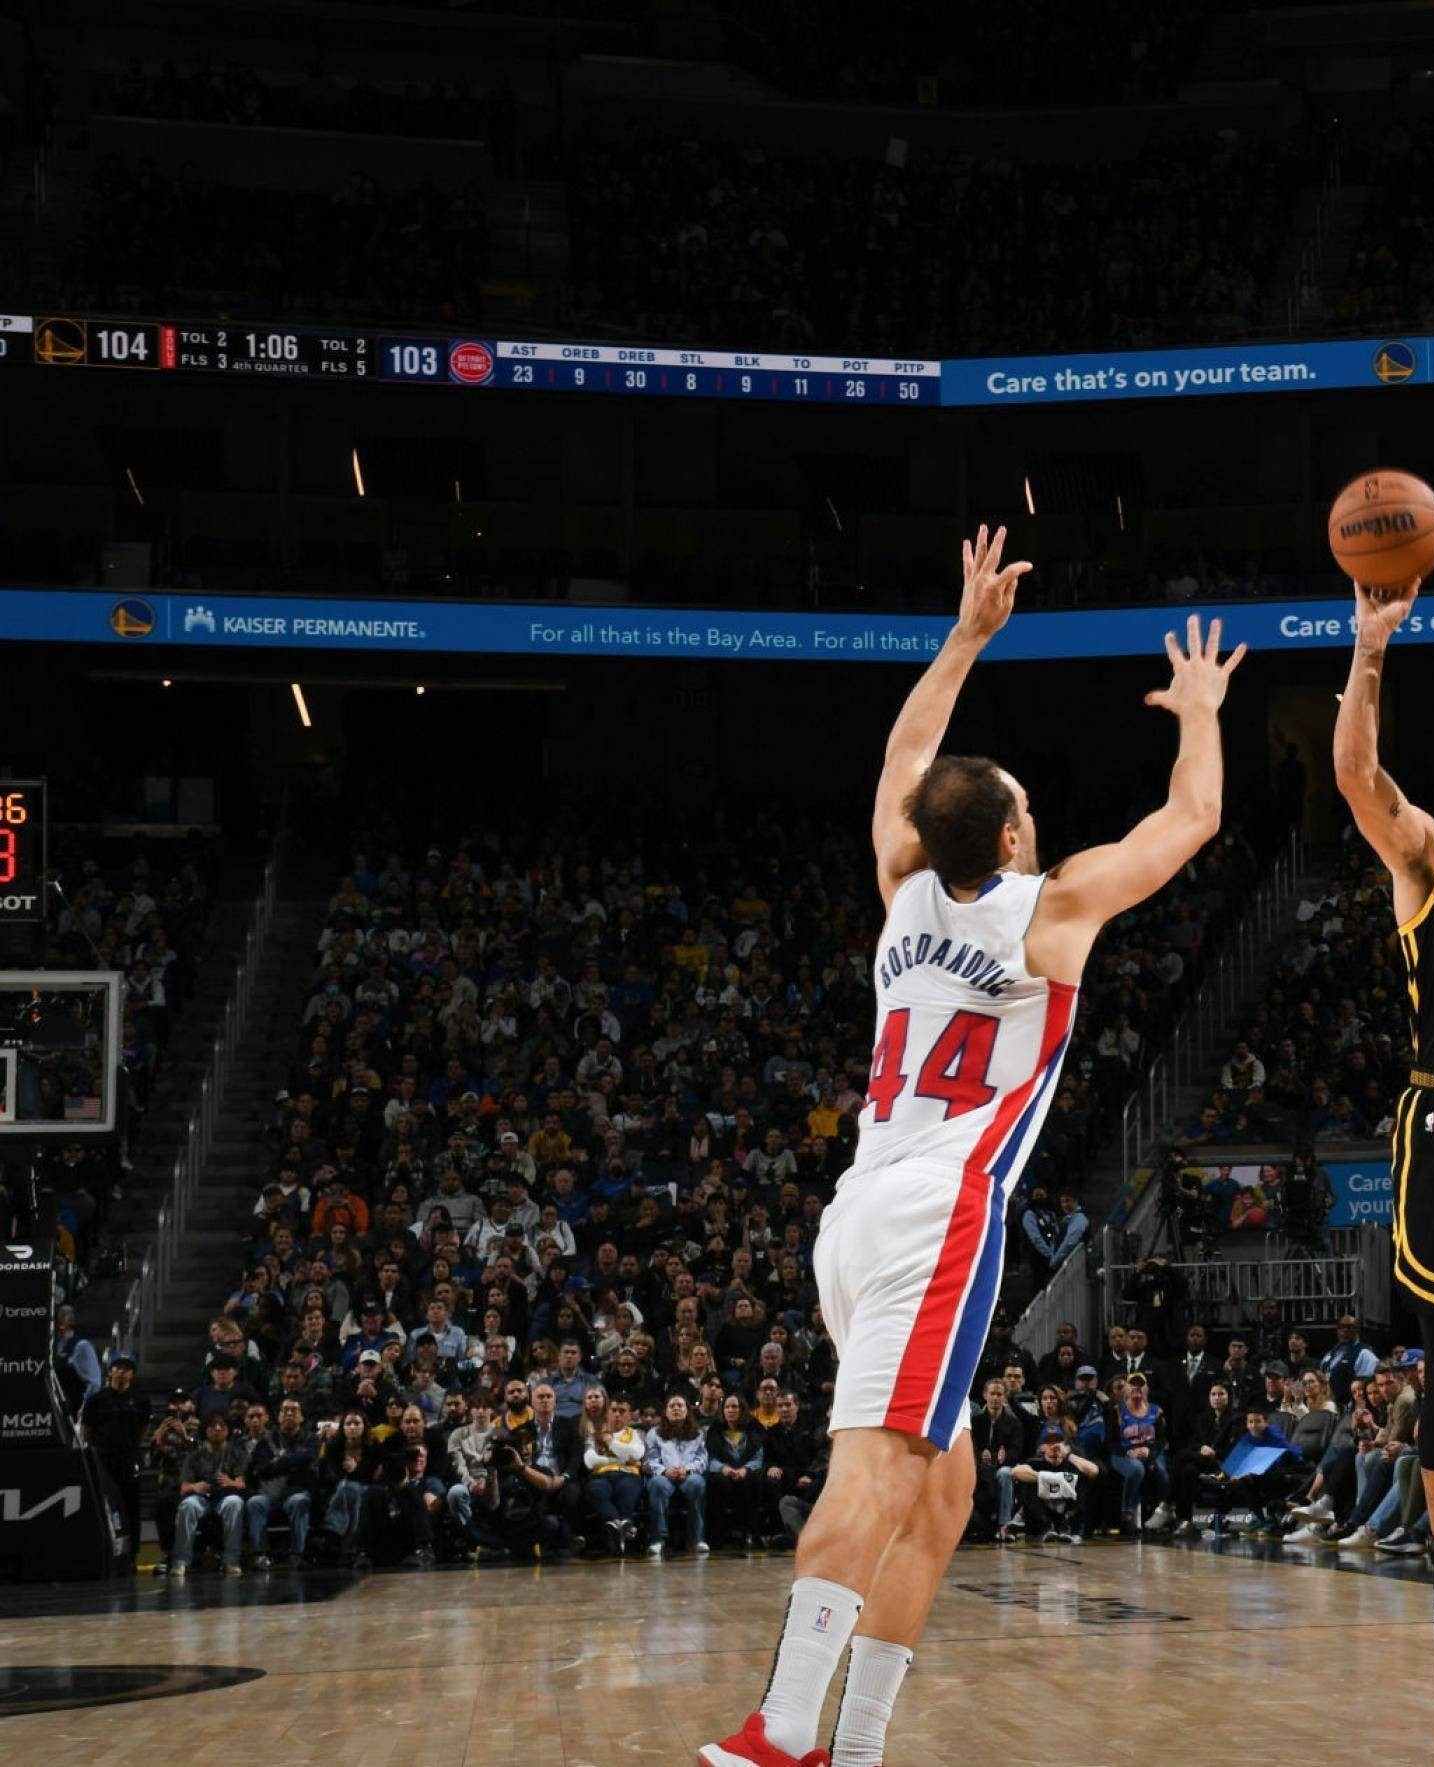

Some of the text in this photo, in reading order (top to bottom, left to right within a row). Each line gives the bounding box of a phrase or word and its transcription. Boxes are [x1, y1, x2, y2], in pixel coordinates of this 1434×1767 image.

[97, 330, 148, 361] 104
[181, 331, 227, 348] TOL 2
[245, 333, 298, 360] 1:06
[320, 338, 367, 354] TOL 2
[181, 353, 227, 369] FLS 3
[232, 361, 309, 374] 4th QUARTER
[321, 361, 367, 376] FLS 5
[389, 346, 438, 376] 103
[511, 345, 925, 374] AST OREB DREB STL BLK TO POT PITP
[513, 365, 919, 400] 23 9 30 8 9 11 26 50
[987, 362, 1316, 395] Care that's on your team.
[223, 616, 287, 635] KAISER
[1280, 615, 1341, 637] Care
[530, 624, 940, 652] For all that is the Bay Area. For all that is
[0, 793, 26, 824] 6
[0, 895, 37, 910] OT
[865, 1007, 1001, 1123] 44
[1348, 1173, 1393, 1192] Care
[1348, 1200, 1394, 1220] your
[5, 1306, 47, 1317] brave
[2, 1412, 52, 1429] MGM
[1, 1428, 52, 1438] REWARDS
